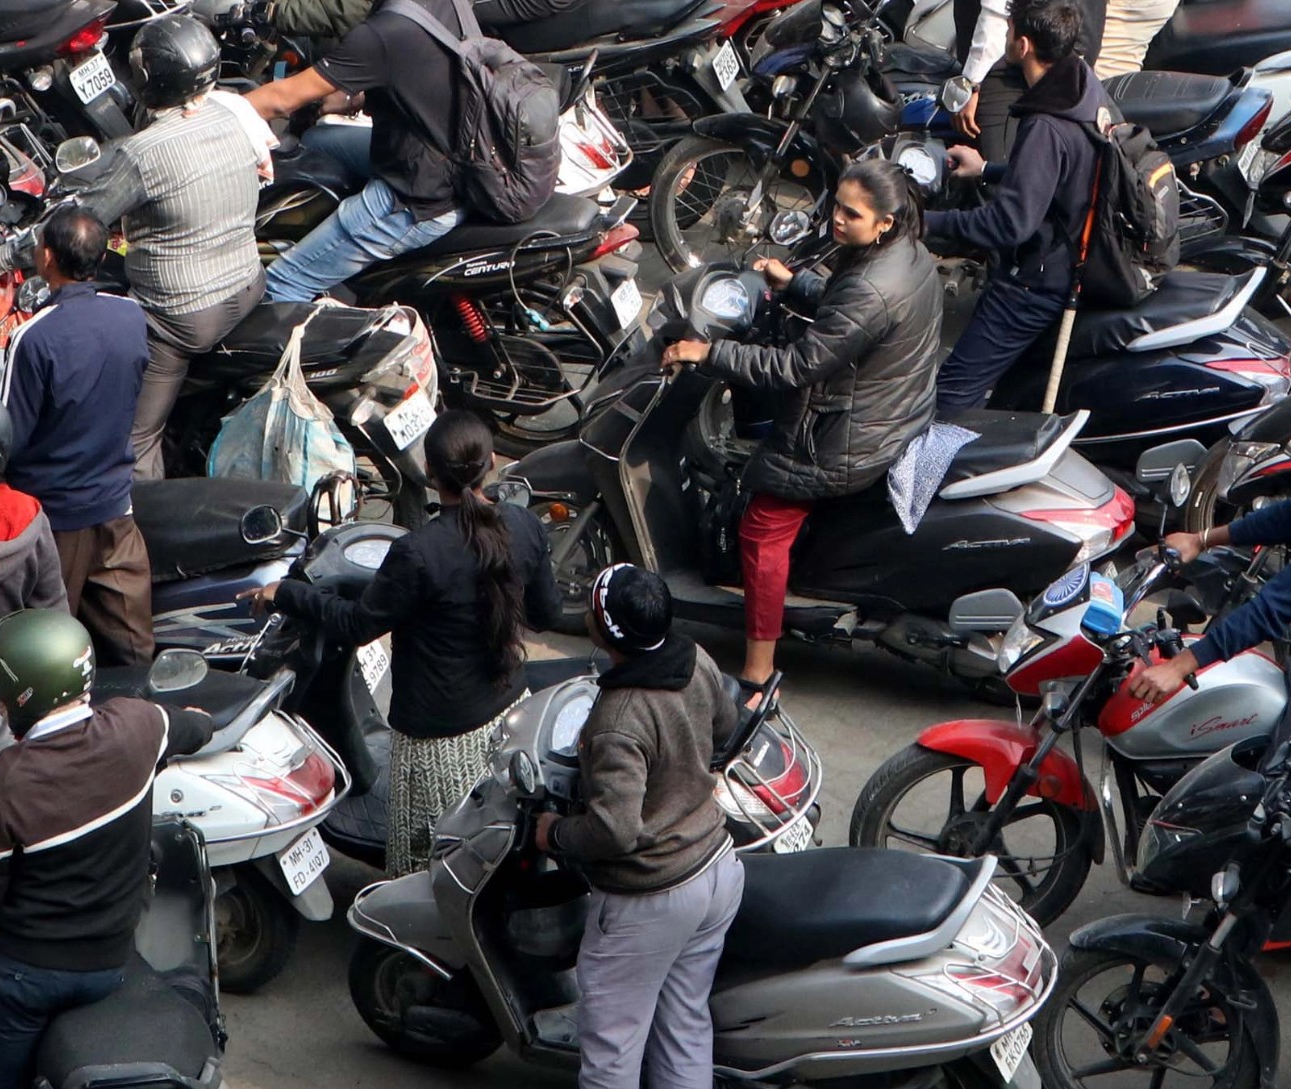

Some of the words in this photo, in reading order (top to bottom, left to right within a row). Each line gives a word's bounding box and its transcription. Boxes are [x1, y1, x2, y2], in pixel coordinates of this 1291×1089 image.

[78, 65, 90, 77] MH
[718, 55, 737, 86] 7365
[464, 262, 516, 276] CENTURO
[310, 368, 338, 378] 100
